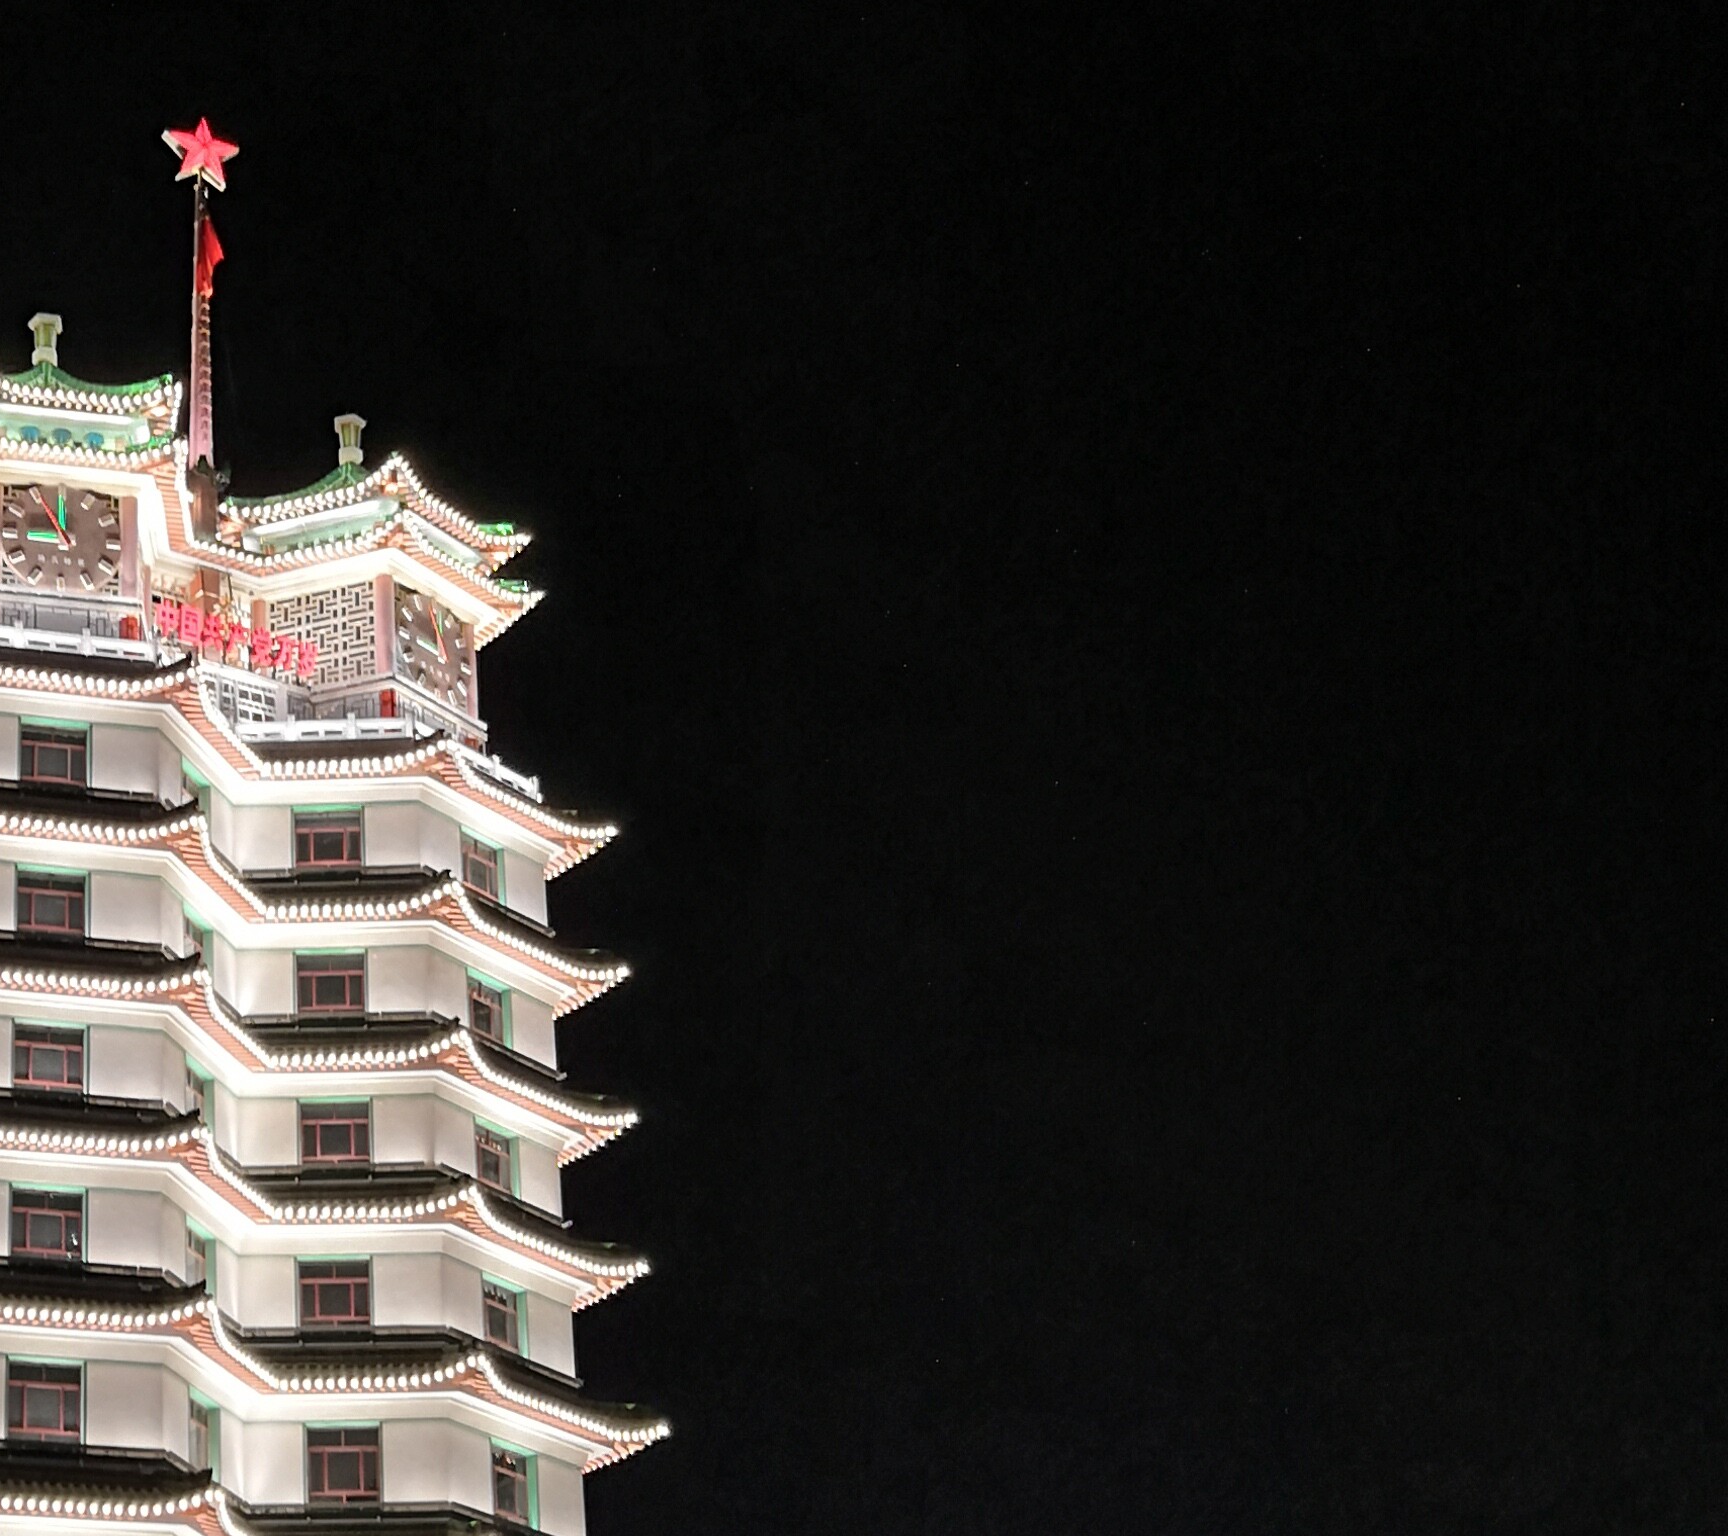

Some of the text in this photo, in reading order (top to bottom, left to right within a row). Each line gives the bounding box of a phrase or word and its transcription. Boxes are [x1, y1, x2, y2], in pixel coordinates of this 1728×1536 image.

[156, 599, 318, 677] 中国共产党万岁
